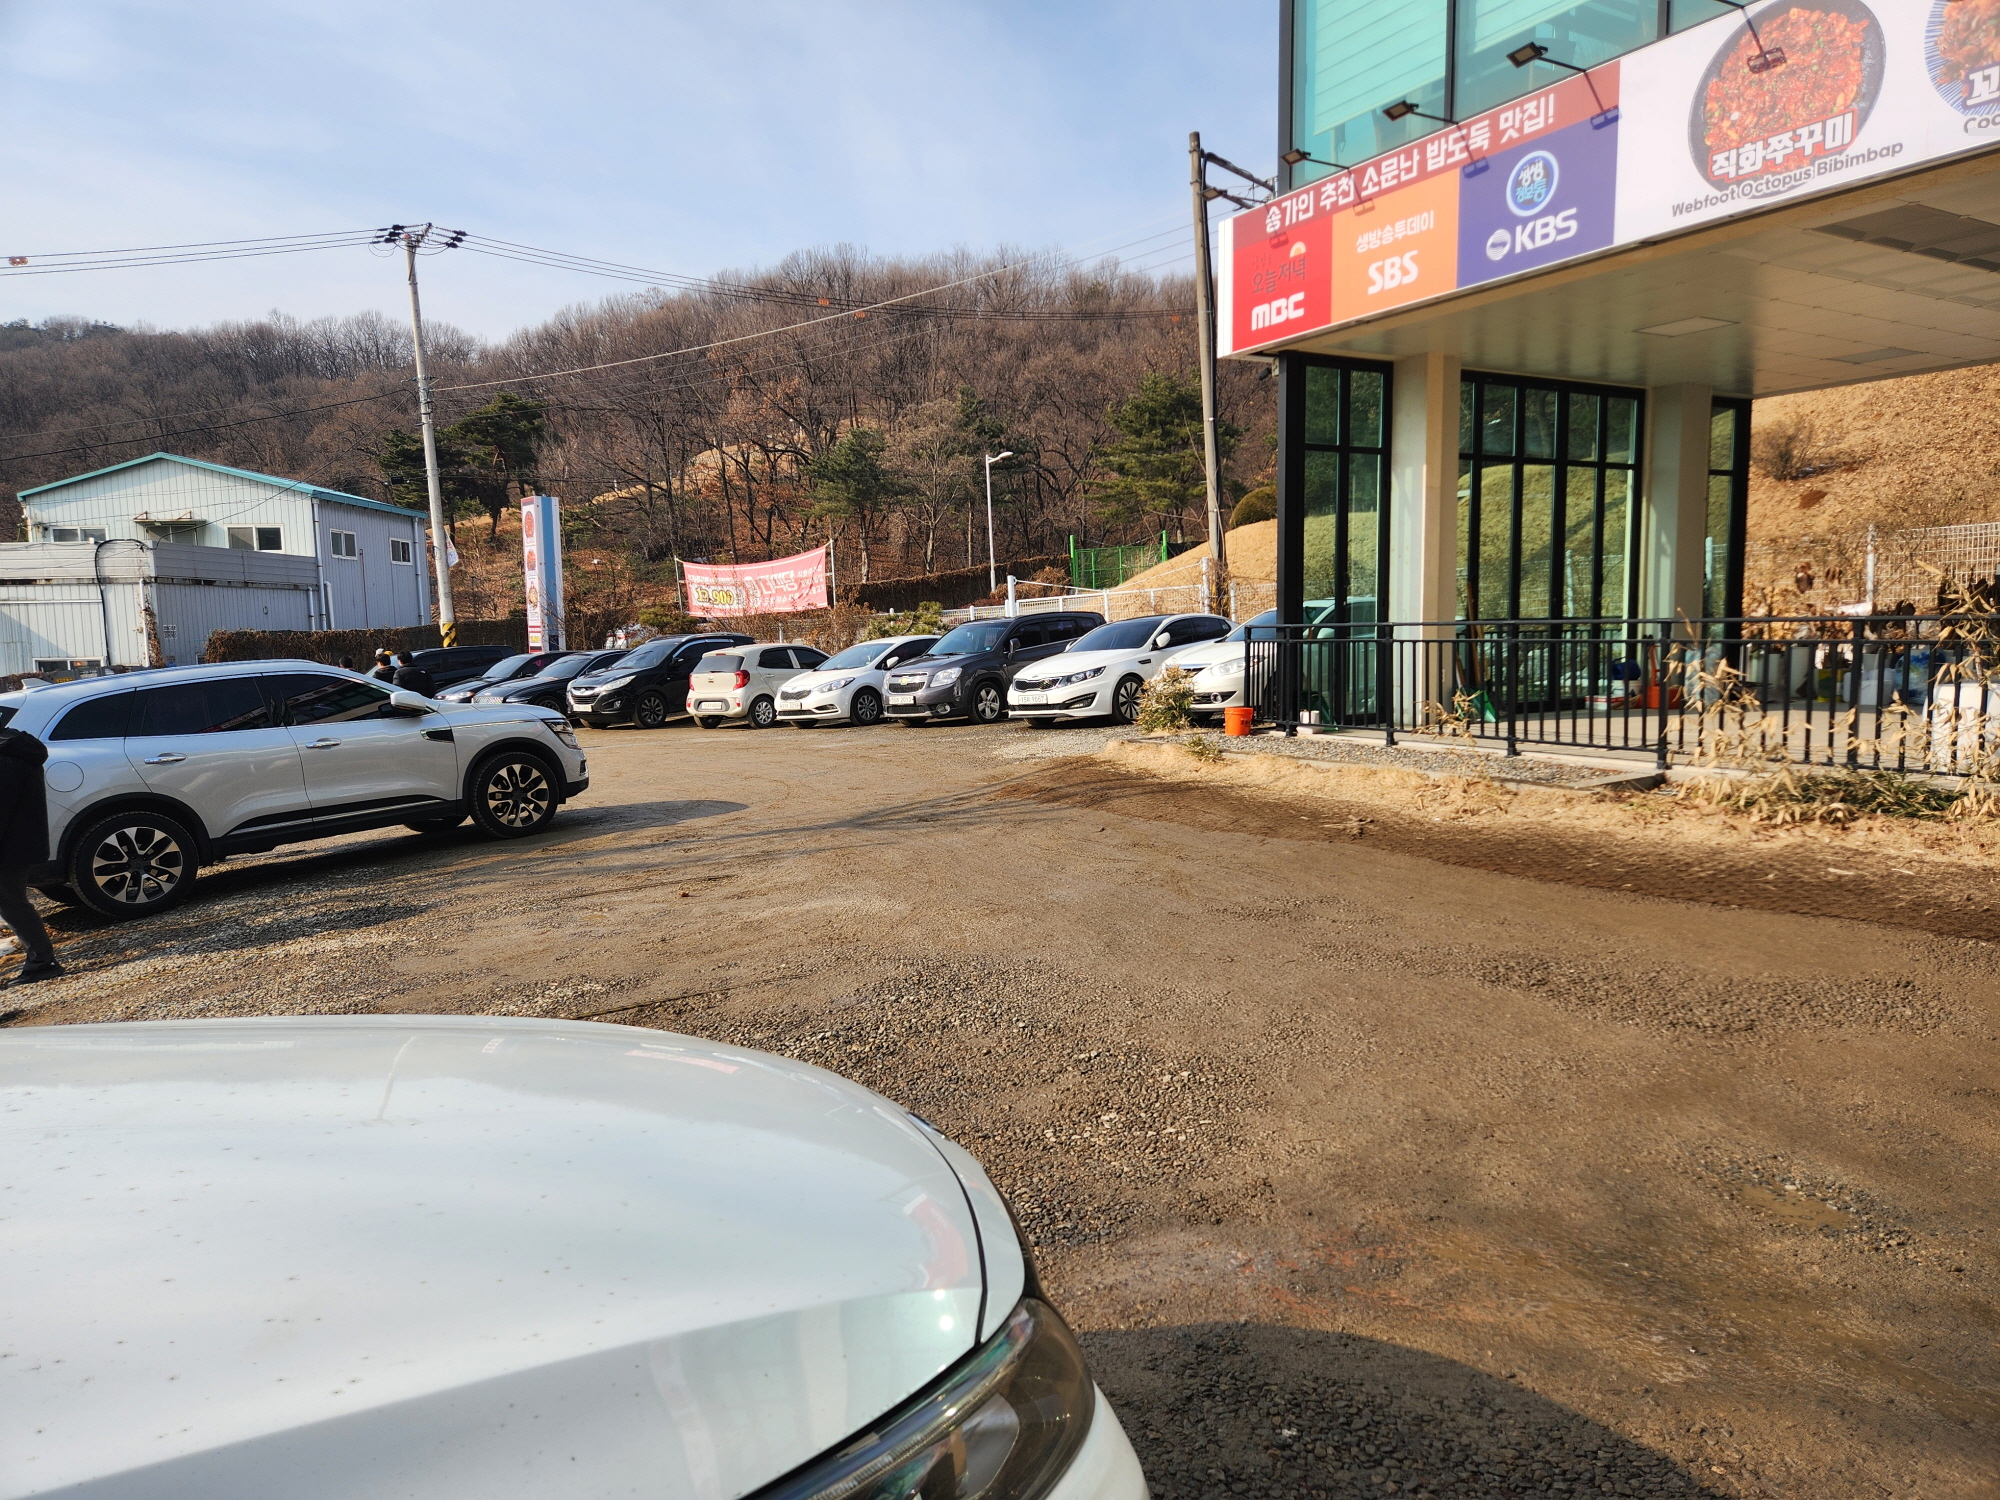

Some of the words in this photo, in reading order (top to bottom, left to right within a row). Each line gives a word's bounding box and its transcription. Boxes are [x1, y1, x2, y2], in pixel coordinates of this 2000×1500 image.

[1265, 190, 1314, 234] 송가인
[1319, 173, 1355, 211] 추천
[1361, 147, 1420, 198] 소문난
[1426, 119, 1491, 172] 밥도둑
[1498, 93, 1555, 144] 맛집!
[1711, 112, 1854, 179] 직화쭈꾸미
[1515, 178, 1547, 203] 정보통
[1671, 187, 1736, 218] Webfoot
[1740, 168, 1812, 199] Octopus
[1816, 141, 1904, 177] Bibimbap
[1356, 209, 1434, 253] 생방송투데이
[1514, 207, 1578, 254] KBS
[1367, 249, 1419, 296] SBS
[1251, 291, 1305, 331] MBC
